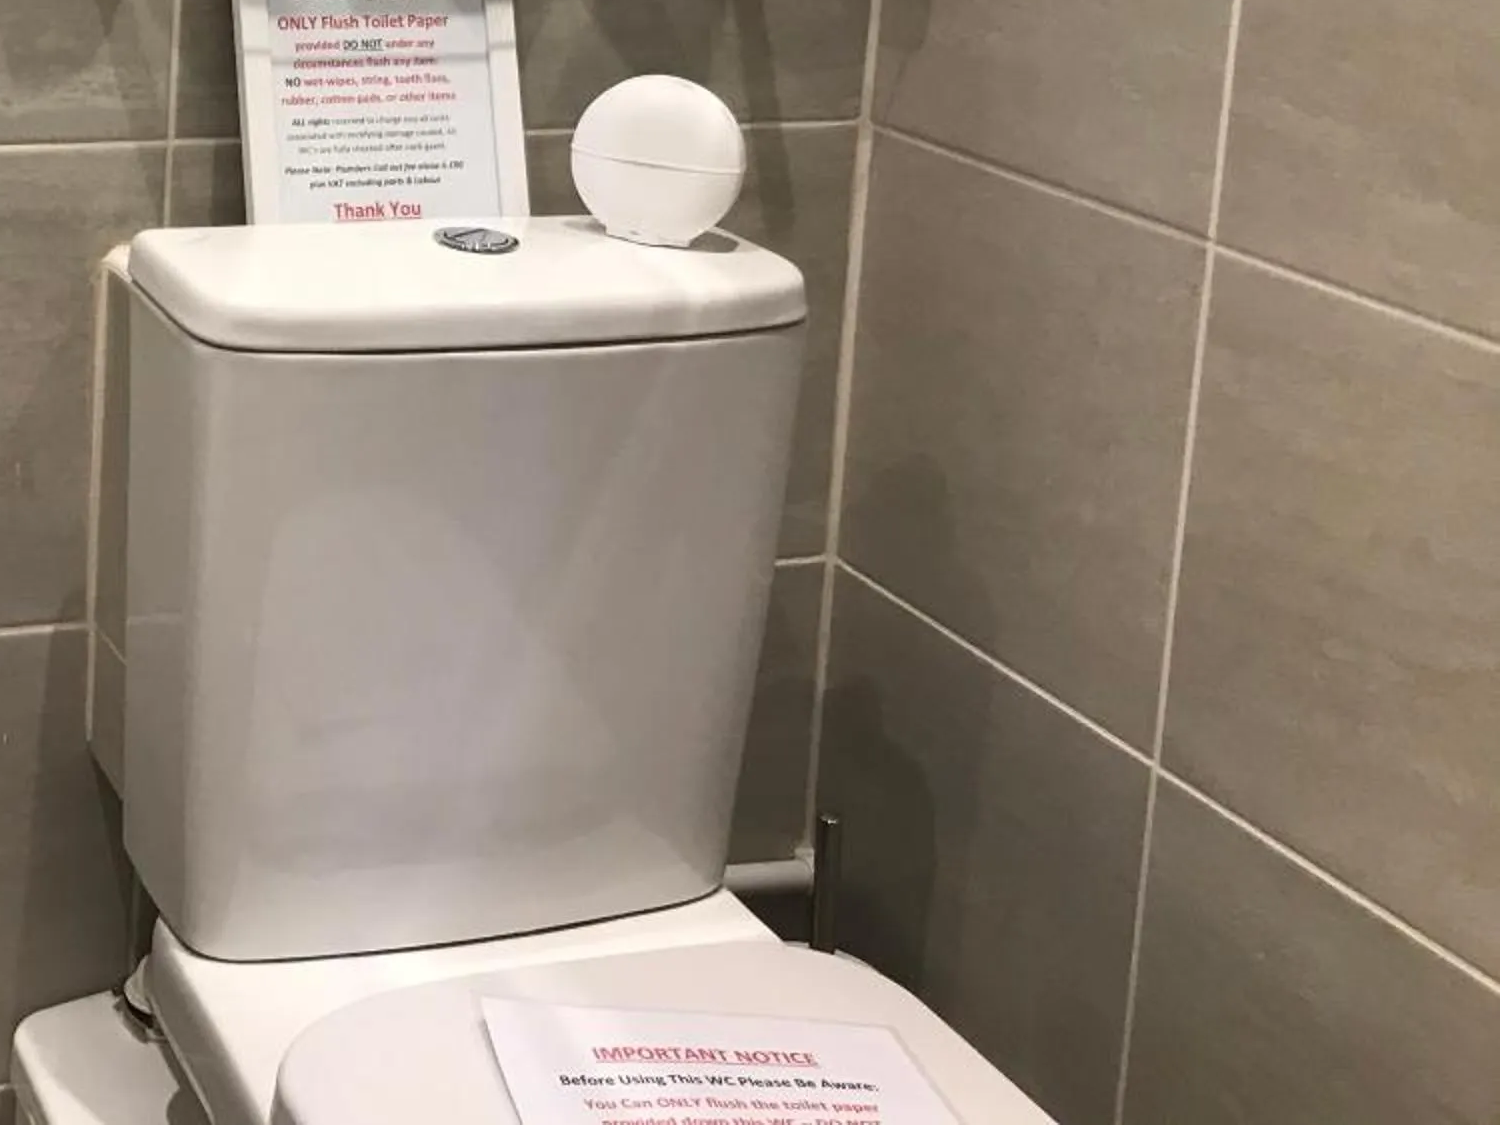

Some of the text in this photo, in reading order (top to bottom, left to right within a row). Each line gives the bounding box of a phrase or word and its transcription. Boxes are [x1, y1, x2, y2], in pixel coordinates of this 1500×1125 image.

[277, 14, 449, 31] ONLY Flush Toilet Paper
[295, 40, 340, 53] provided
[343, 39, 359, 51] DO
[361, 38, 384, 51] NOT
[285, 77, 301, 88] NO
[334, 200, 422, 222] Thank You
[592, 1046, 819, 1068] IMPORTANT NOTICE
[559, 1074, 614, 1087] Before
[618, 1074, 667, 1087] Using
[669, 1074, 703, 1085] This
[705, 1075, 735, 1087] WC
[738, 1076, 792, 1089] Please
[794, 1078, 816, 1089] Be
[584, 1096, 879, 1114] You Can ONLY flush the toilet paper
